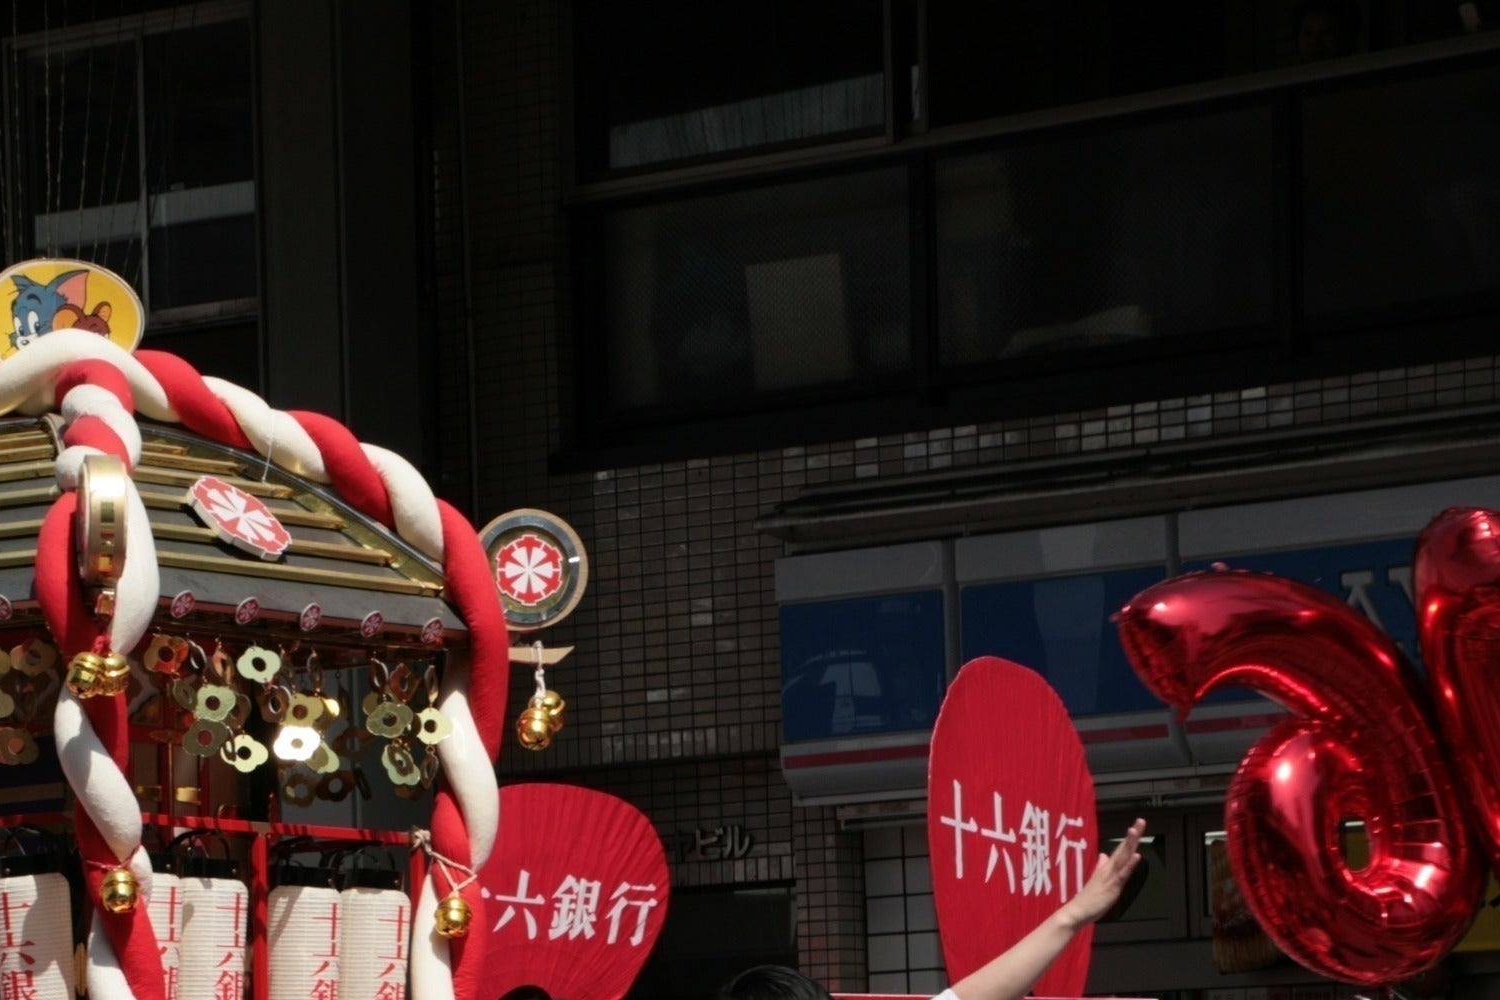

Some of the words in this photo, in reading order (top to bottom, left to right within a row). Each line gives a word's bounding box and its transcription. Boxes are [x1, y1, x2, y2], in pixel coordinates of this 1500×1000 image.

[940, 779, 1087, 903] 十六銀行
[481, 869, 658, 947] 六銀行
